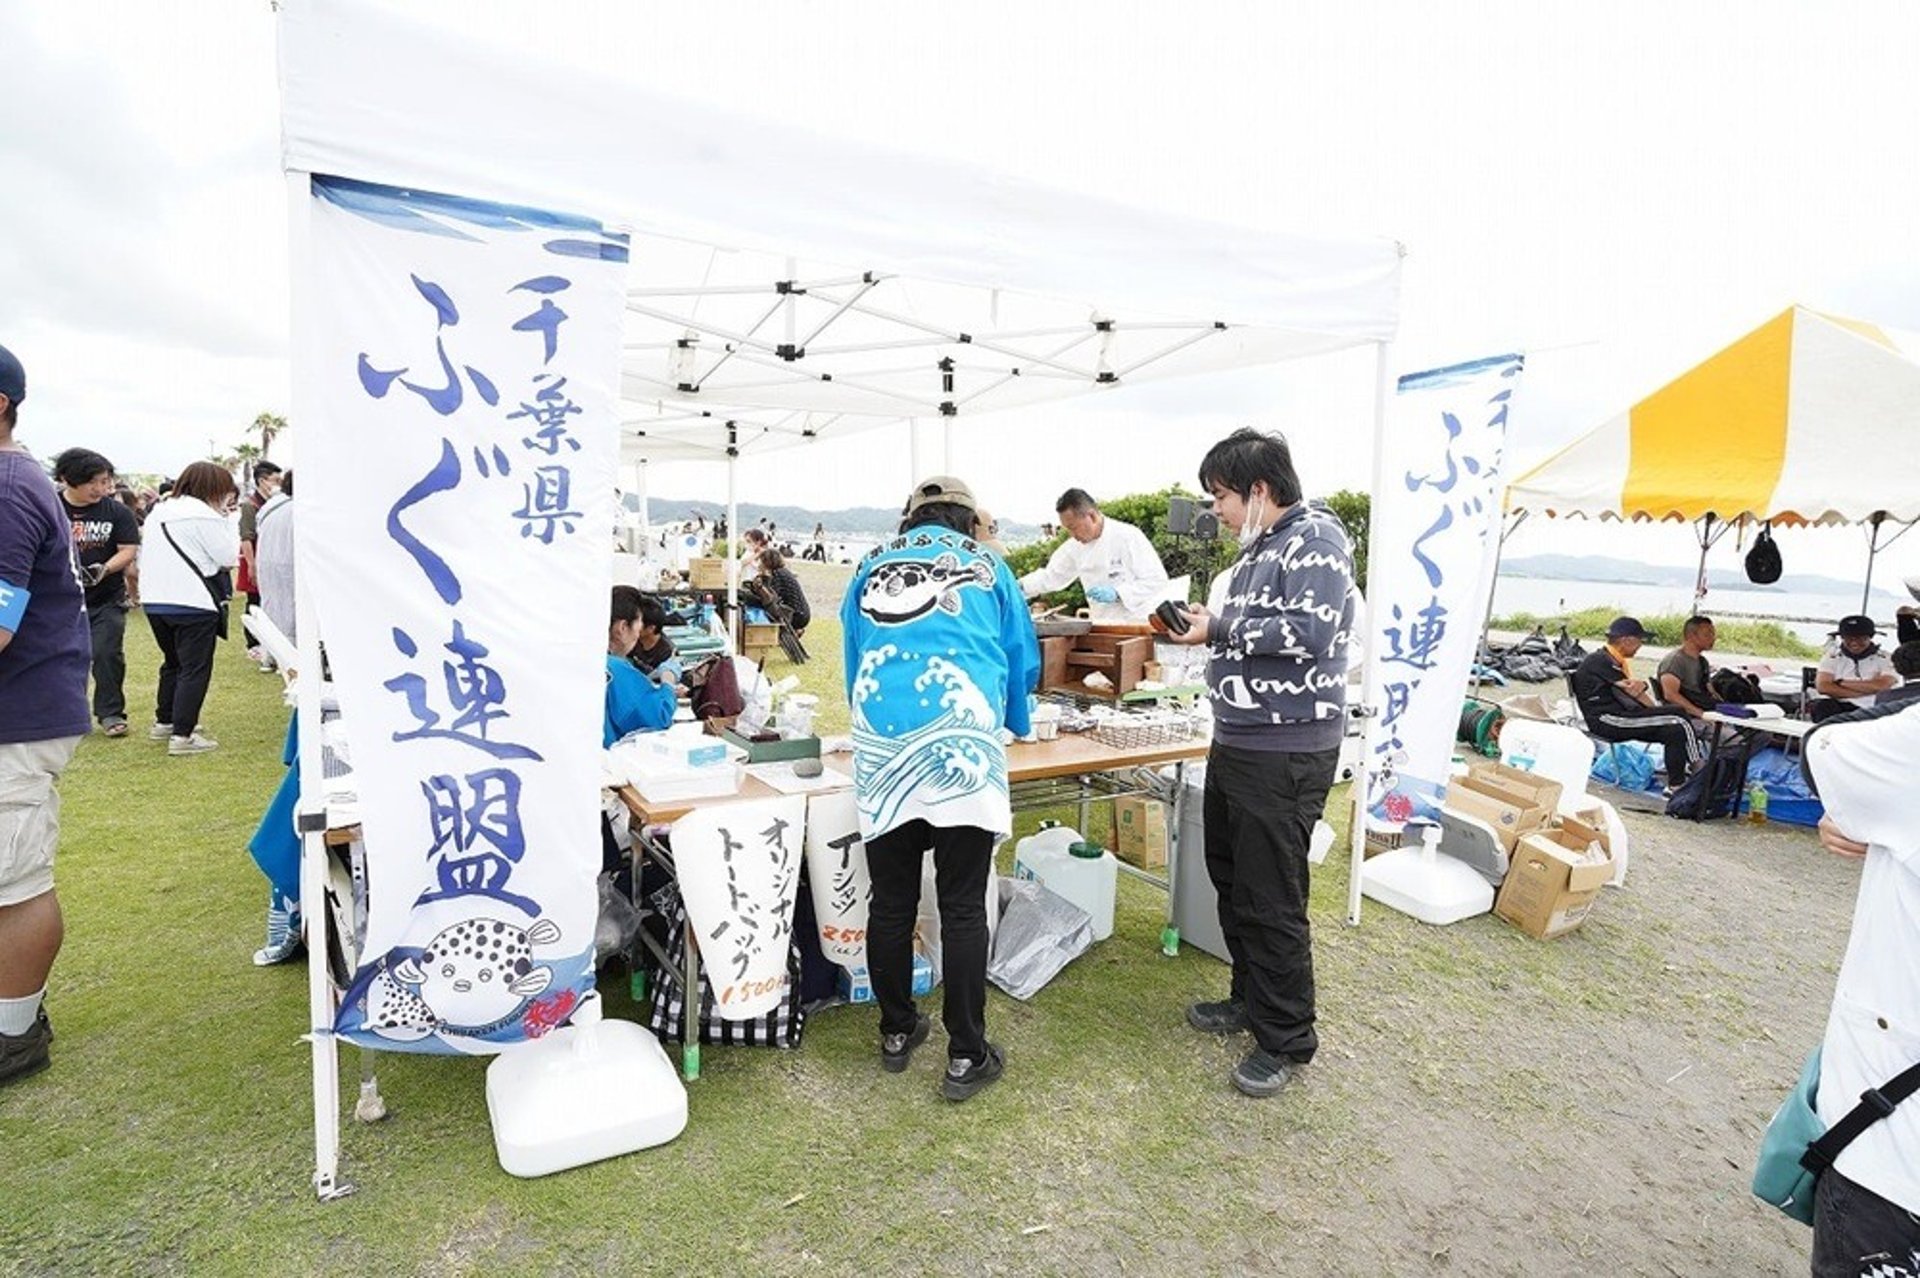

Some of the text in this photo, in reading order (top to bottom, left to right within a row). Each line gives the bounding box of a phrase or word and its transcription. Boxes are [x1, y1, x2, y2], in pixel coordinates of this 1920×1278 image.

[507, 275, 583, 544] 千葉県
[358, 273, 545, 917] ふぐ連盟
[710, 827, 762, 981] トートバッグ
[759, 816, 793, 940] オリジナル
